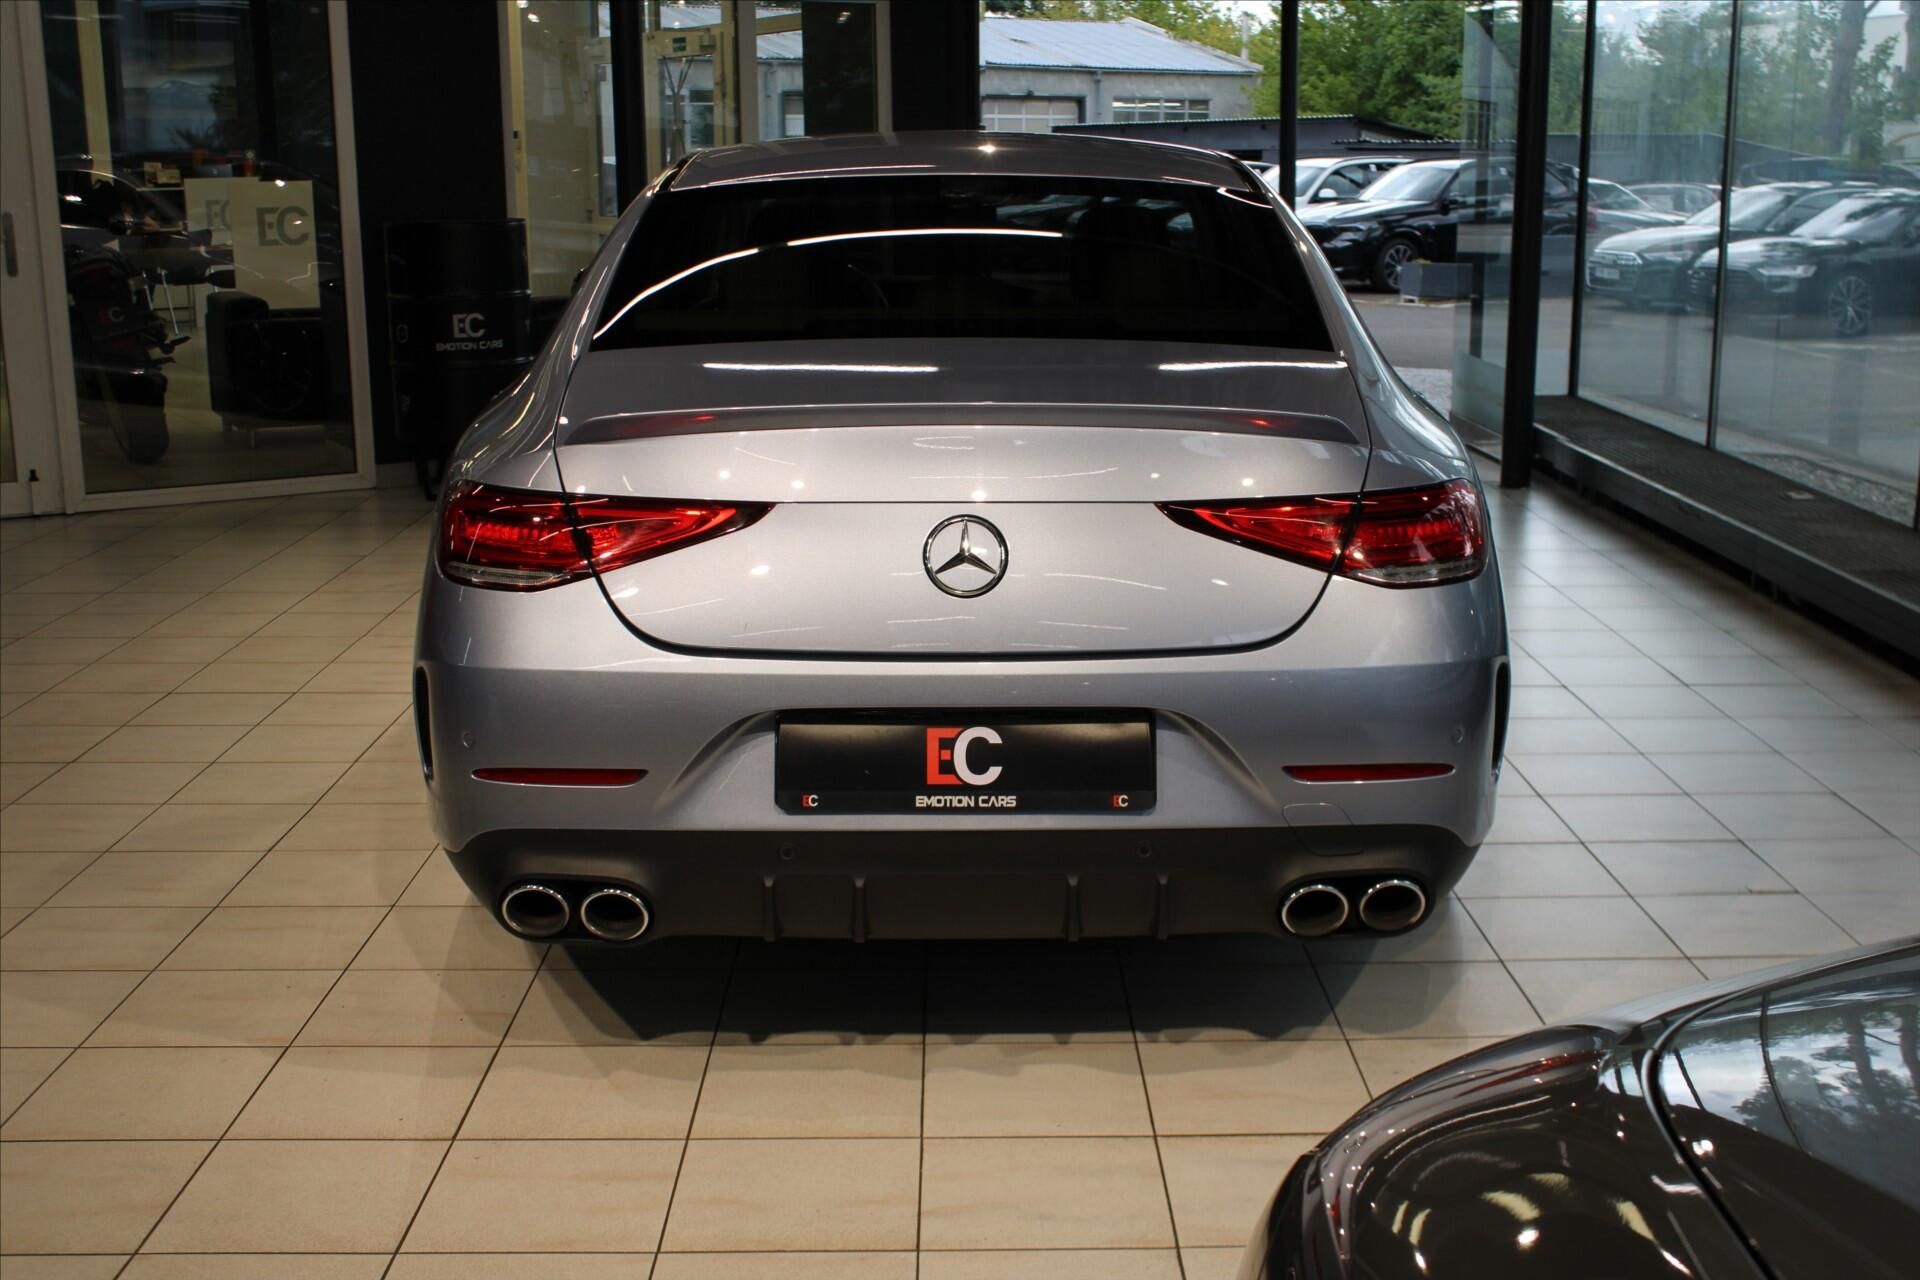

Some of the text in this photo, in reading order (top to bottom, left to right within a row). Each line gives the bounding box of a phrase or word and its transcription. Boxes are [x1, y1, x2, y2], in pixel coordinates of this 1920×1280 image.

[256, 206, 310, 246] EC
[452, 312, 486, 338] EC
[926, 726, 1003, 786] EC
[802, 794, 819, 808] EC
[915, 795, 1017, 808] EMOTION CARS
[1113, 794, 1129, 808] EC
